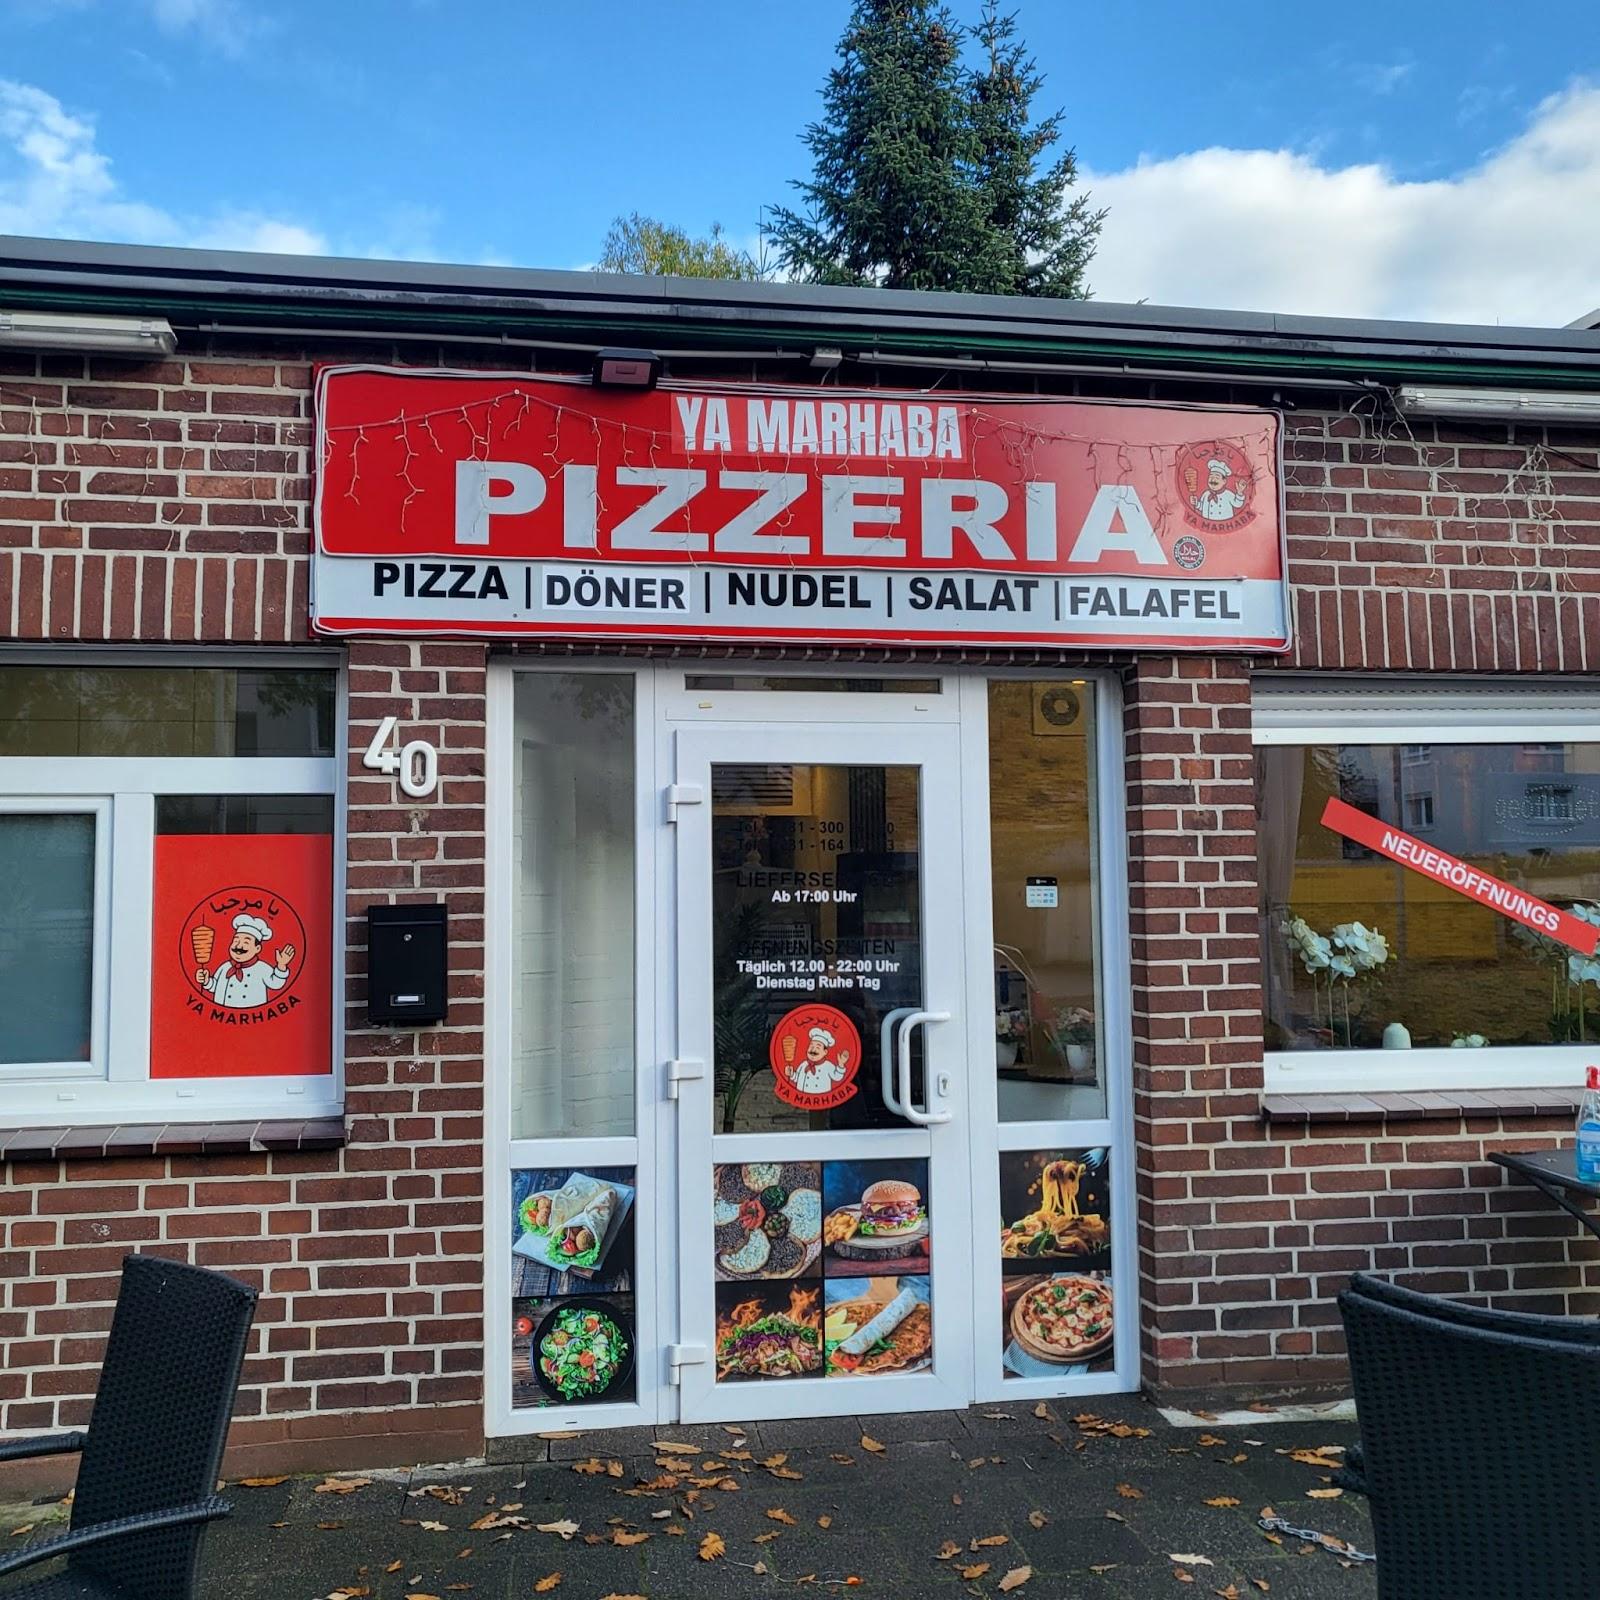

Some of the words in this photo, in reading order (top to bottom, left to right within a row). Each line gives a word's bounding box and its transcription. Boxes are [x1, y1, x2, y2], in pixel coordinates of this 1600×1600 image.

[675, 396, 732, 453] YA
[746, 398, 964, 460] MARHABA
[454, 459, 1169, 566] PIZZERIA
[1186, 511, 1198, 526] YA
[1201, 510, 1255, 531] MARHABA
[373, 561, 509, 600] PIZZA
[545, 568, 687, 610] DÖNER
[728, 572, 872, 609] NUDEL
[908, 576, 1040, 612] SALAT
[1069, 585, 1241, 620] FALAFEL
[363, 716, 438, 797] 40
[820, 821, 844, 833] 300
[820, 839, 844, 850] 164
[1380, 830, 1561, 932] NEUERÖFFNUNGS
[771, 890, 791, 902] Ab
[794, 890, 829, 902] 17:00
[832, 890, 857, 902] Uhr
[736, 959, 786, 975] Täglich
[789, 960, 825, 972] 12.00
[836, 960, 872, 972] 22:00
[875, 960, 901, 972] Uhr
[756, 975, 816, 991] Dienstag
[818, 976, 854, 988] Ruhe
[856, 976, 881, 991] Tag
[185, 994, 205, 1016] YA
[209, 994, 302, 1025] MARHABA
[779, 1083, 790, 1098] YA
[793, 1085, 853, 1106] MARHABA
